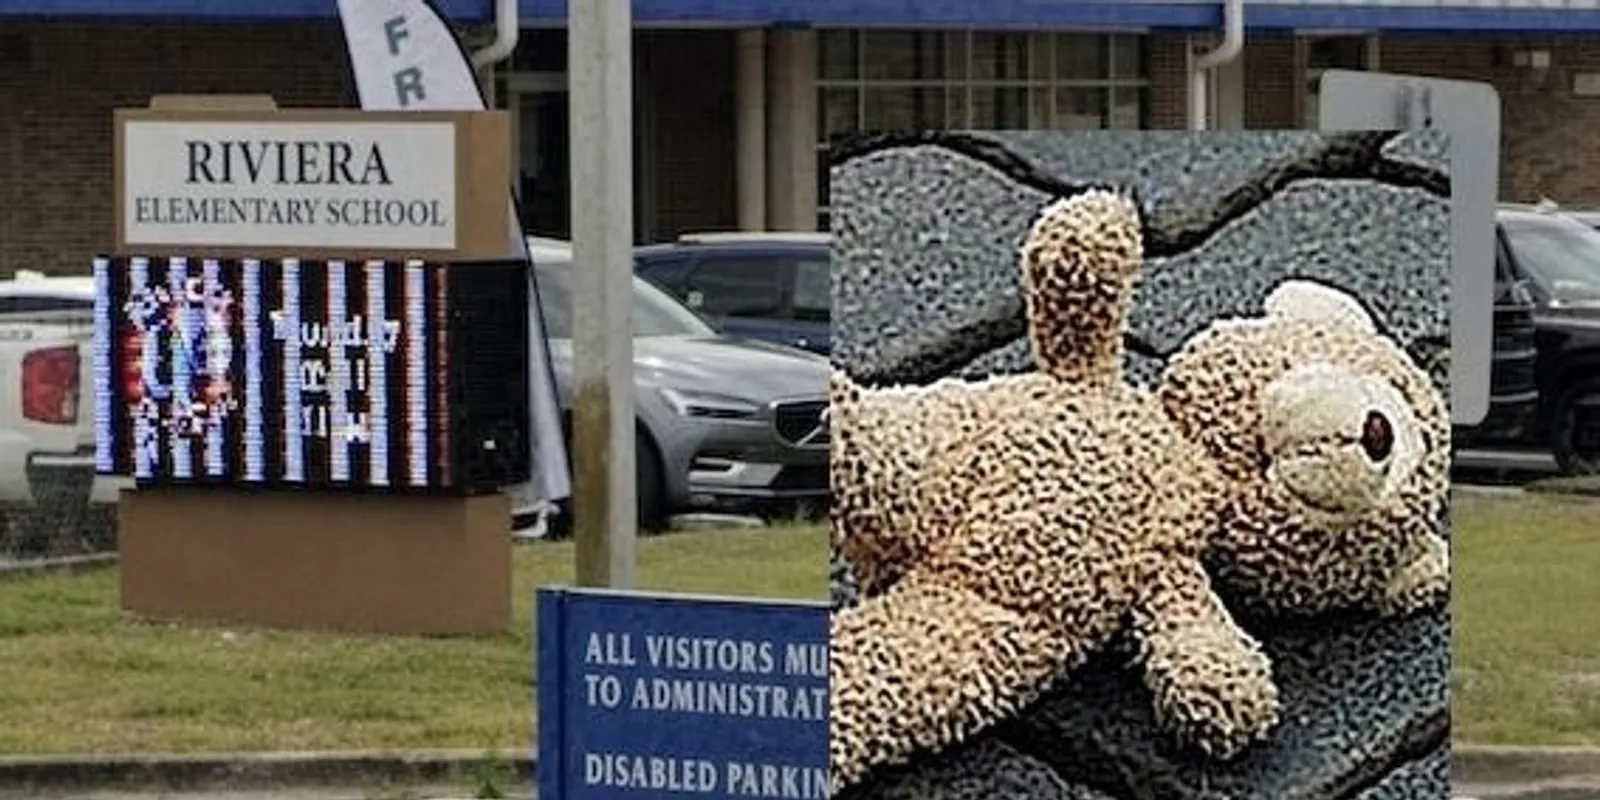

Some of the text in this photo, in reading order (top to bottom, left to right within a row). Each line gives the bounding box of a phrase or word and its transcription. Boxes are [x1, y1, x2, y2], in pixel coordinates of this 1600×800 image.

[184, 140, 393, 186] RIVIERA
[135, 196, 447, 228] ELEMENTARY SCHOOL
[585, 632, 636, 666] ALL
[645, 635, 774, 674] VISITORS
[584, 674, 828, 720] TO ADMINISTRAT
[586, 754, 717, 792] DISABLED
